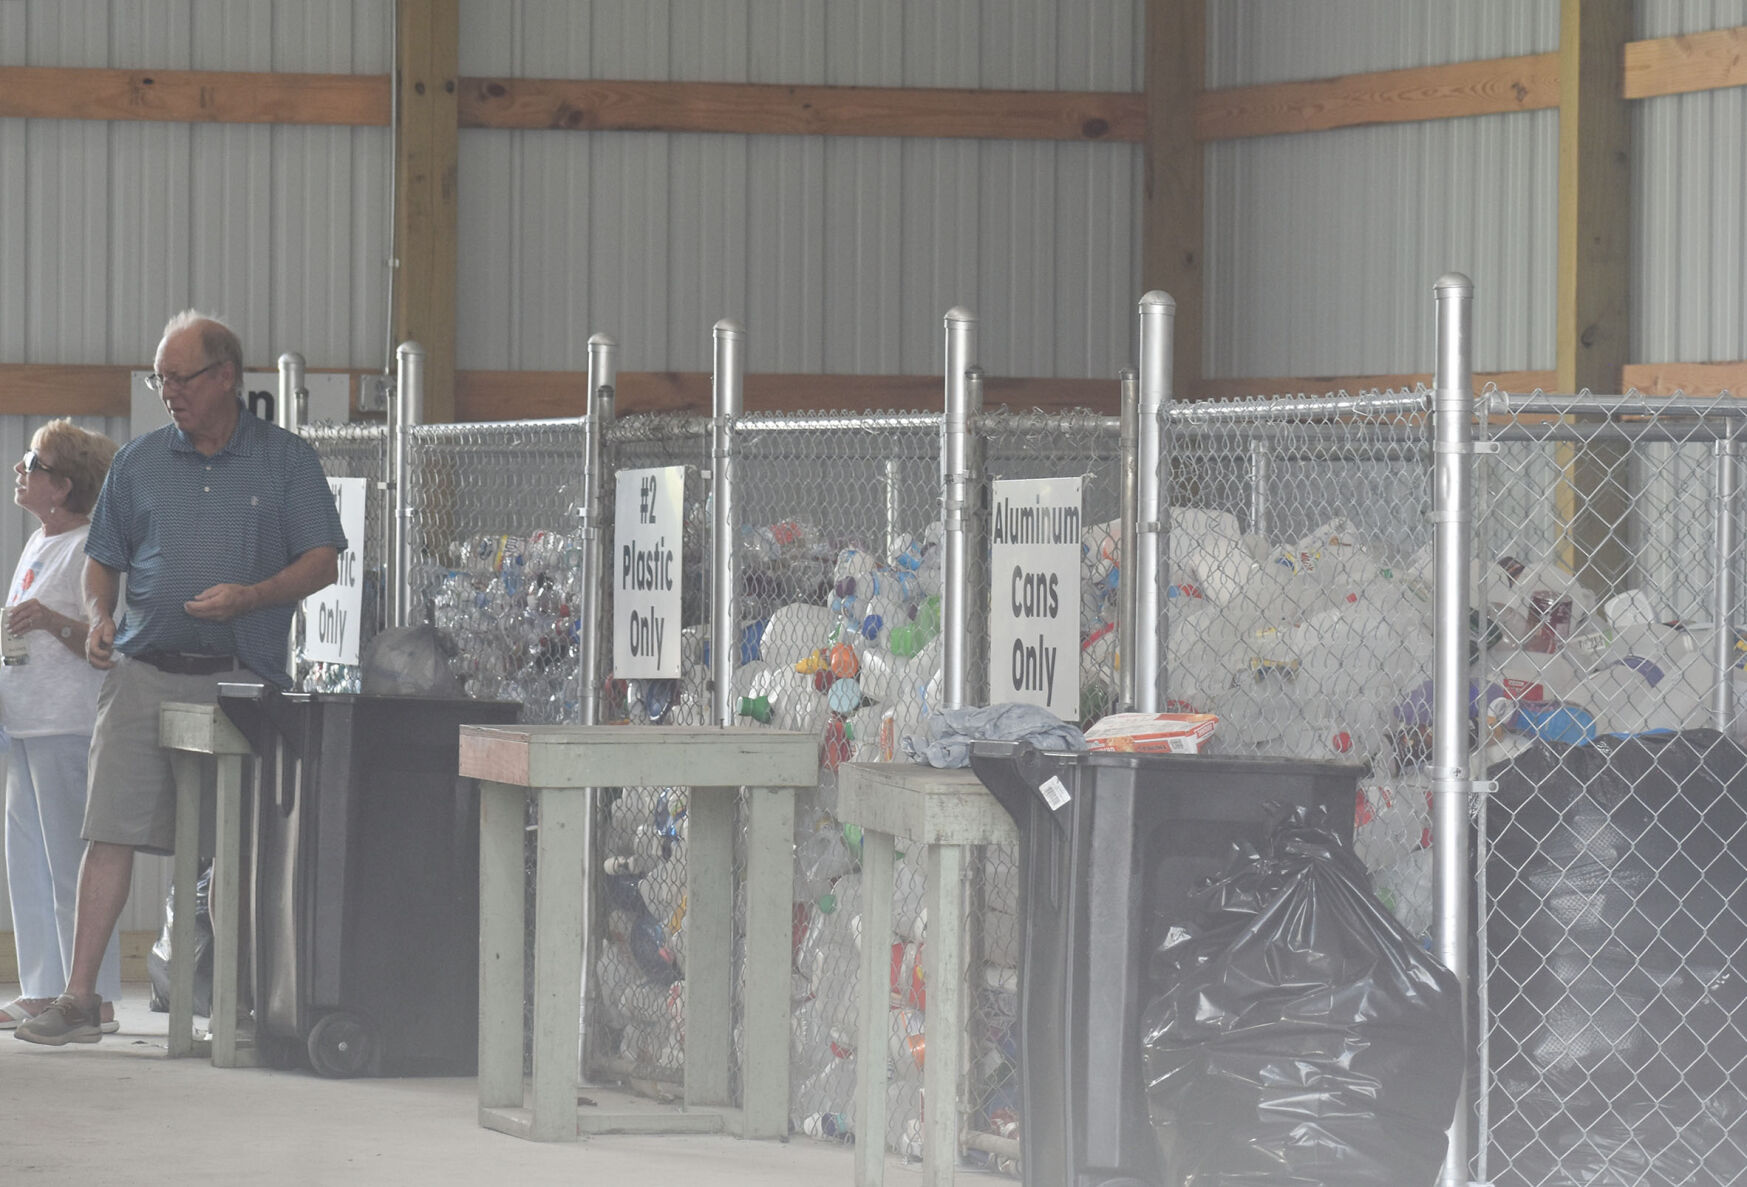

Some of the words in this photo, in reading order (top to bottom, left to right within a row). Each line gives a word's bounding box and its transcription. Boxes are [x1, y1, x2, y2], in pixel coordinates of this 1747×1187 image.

[639, 475, 657, 524] #2
[993, 494, 1080, 544] Aluminum
[622, 536, 673, 591] Plastic
[1011, 565, 1059, 619] Cans
[318, 599, 347, 657] Only
[630, 606, 665, 671] Only
[1012, 634, 1057, 707] Only
